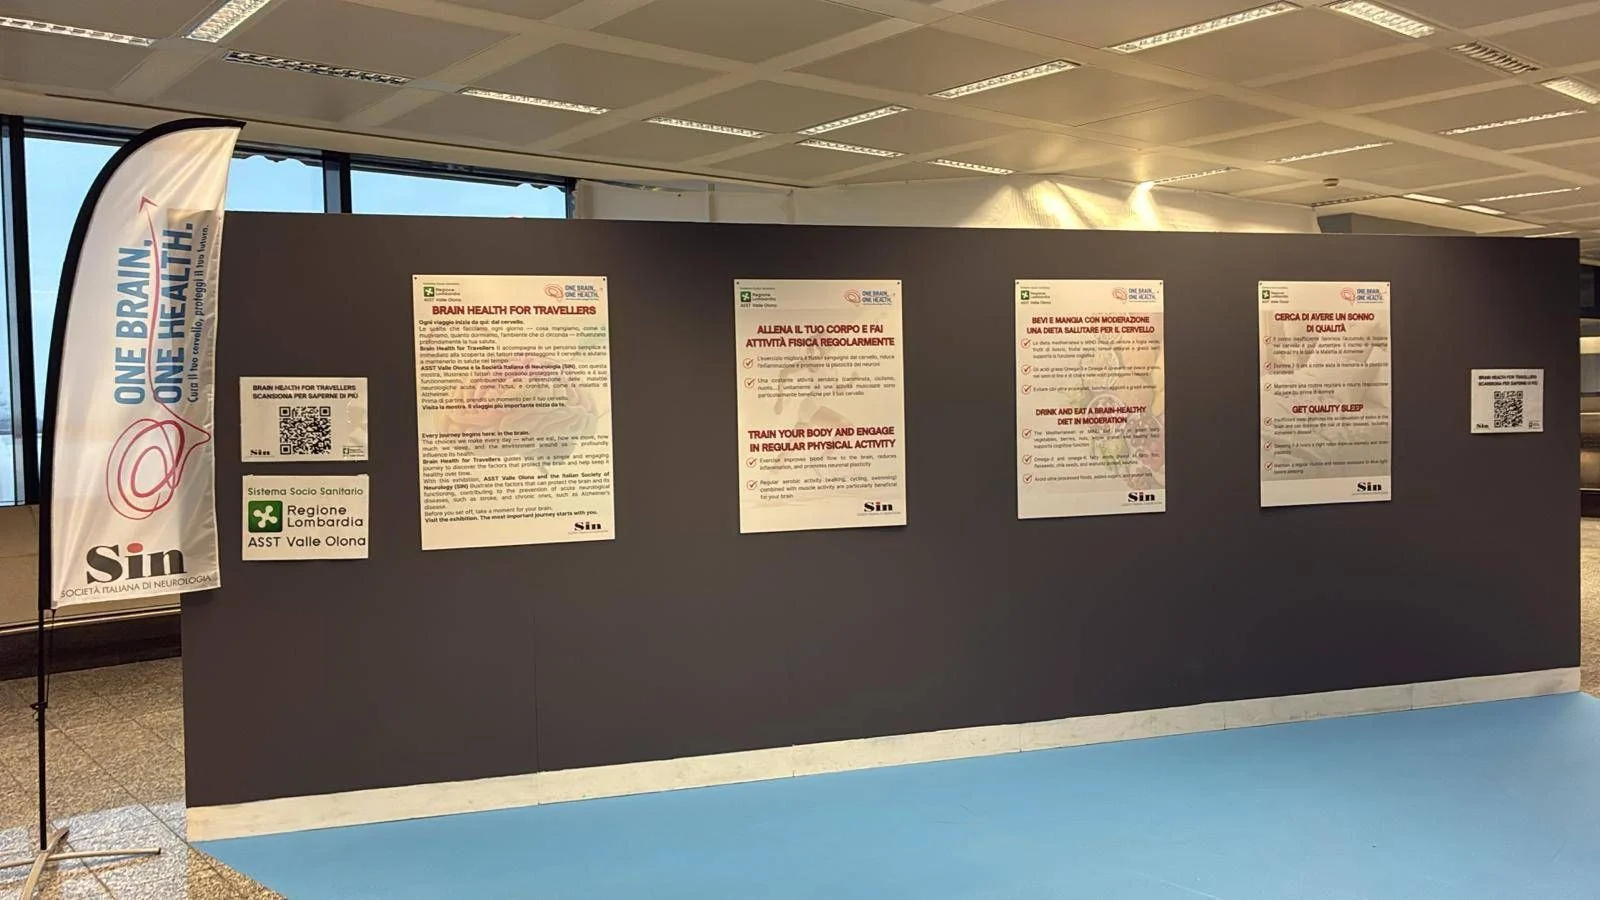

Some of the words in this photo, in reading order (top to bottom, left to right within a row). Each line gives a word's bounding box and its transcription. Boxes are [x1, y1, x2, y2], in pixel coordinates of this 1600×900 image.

[196, 254, 204, 268] tuo
[158, 223, 193, 338] HEALTH.
[116, 239, 153, 338] BRAIN,
[194, 279, 207, 316] proteggi
[432, 306, 465, 315] BRAIN
[467, 306, 507, 315] HEALTH
[510, 306, 531, 315] FOR
[533, 306, 596, 315] TRAVELLERS
[757, 325, 793, 334] ALLENA
[795, 325, 803, 334] IL
[804, 325, 825, 334] TUO
[826, 325, 860, 333] CORPO
[862, 325, 868, 333] E
[870, 325, 883, 333] FAI
[1315, 324, 1346, 332] QUALITÀ
[191, 319, 204, 355] cervello,
[746, 336, 786, 347] ATTIVITÀ
[788, 338, 819, 347] FISICA
[820, 337, 895, 346] REGOLARMENTE
[190, 358, 198, 372] tuo
[114, 347, 146, 404] ONE
[154, 347, 184, 404] ONE
[188, 380, 199, 403] Cura
[1094, 406, 1146, 414] BRAIN-HEALTHY
[748, 430, 776, 439] TRAIN
[778, 429, 805, 438] YOUR
[807, 428, 832, 437] BODY
[835, 428, 854, 437] AND
[857, 427, 894, 436] ENGAGE
[750, 444, 759, 452] IN
[762, 442, 805, 452] REGULAR
[807, 441, 853, 450] PHYSICAL
[854, 439, 895, 449] ACTIVITY
[1357, 482, 1382, 491] Sin
[1128, 492, 1155, 502] Sin
[288, 505, 347, 517] Regione
[863, 501, 893, 512] Sin
[288, 517, 363, 527] Lombardia
[574, 522, 602, 531] Sin
[248, 537, 281, 547] ASST
[287, 536, 321, 547] Valle
[325, 536, 366, 546] Olona
[86, 542, 187, 584] Sin
[61, 585, 100, 598] SOCIETÀ
[102, 583, 140, 594] ITALIANA
[142, 581, 152, 589] DI
[154, 576, 212, 588] NEUROLOGIA
